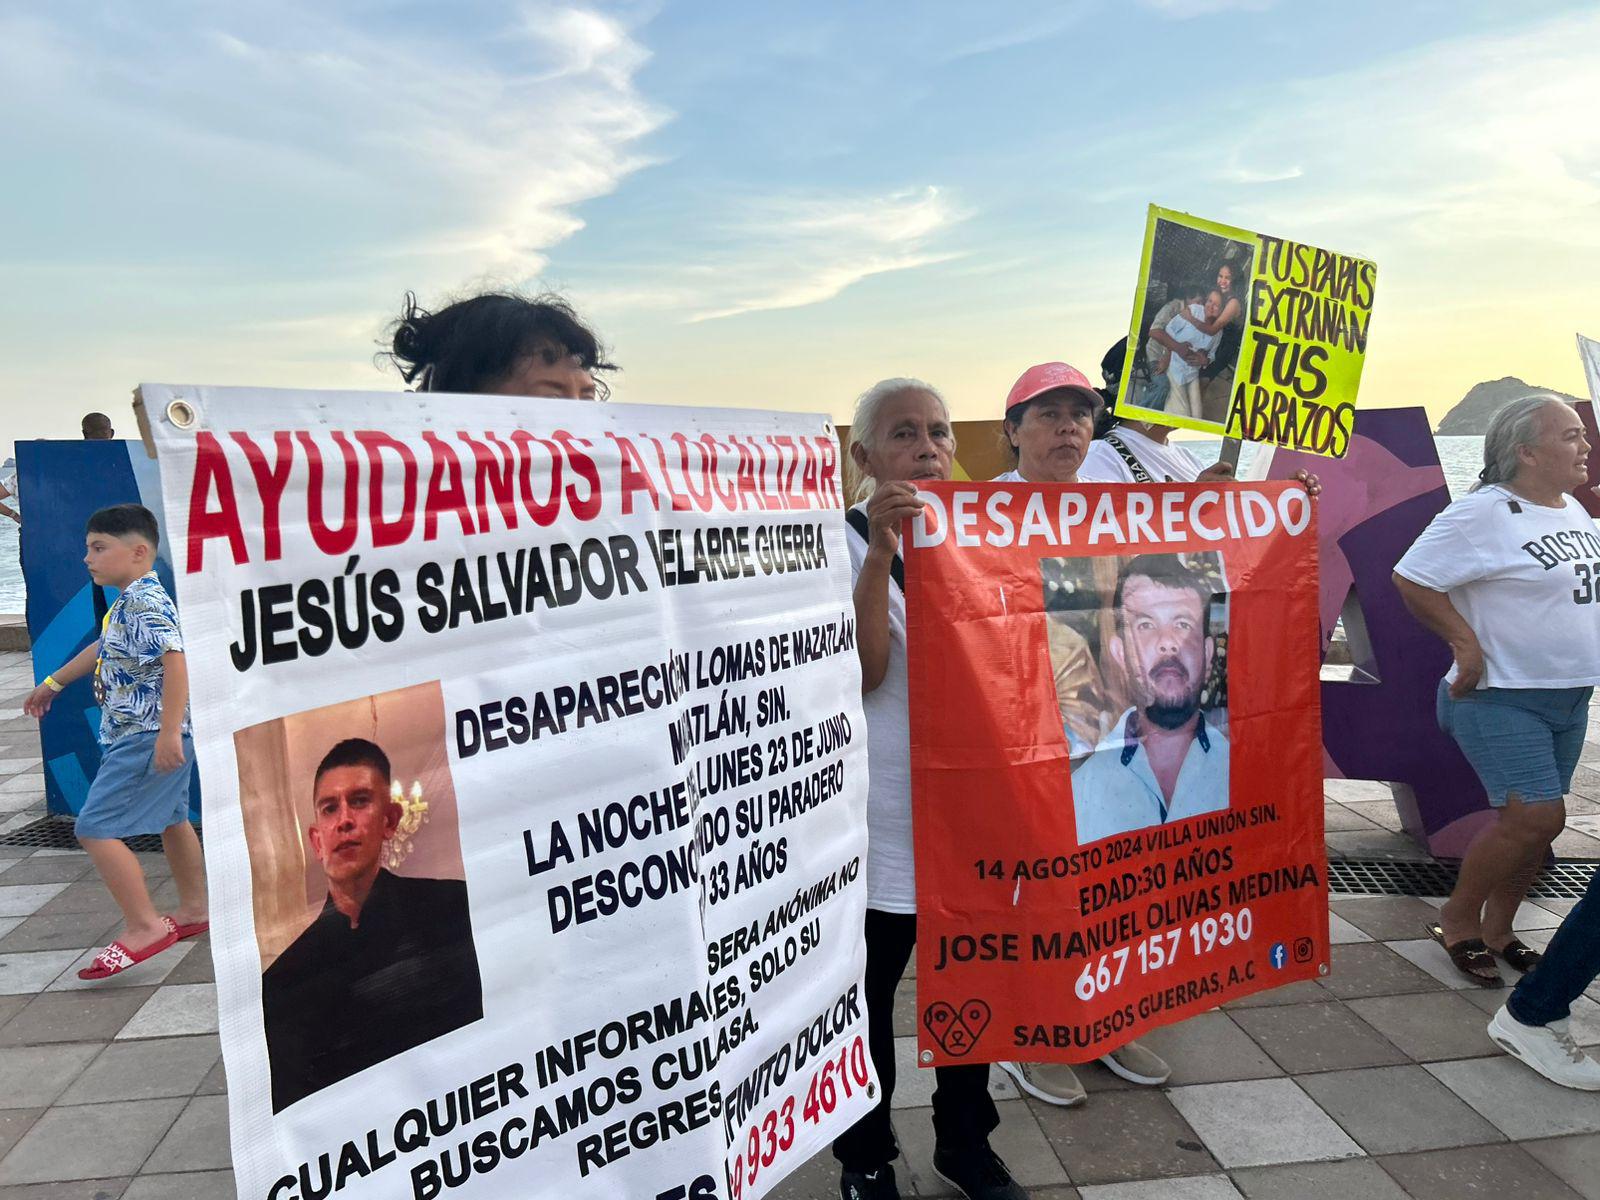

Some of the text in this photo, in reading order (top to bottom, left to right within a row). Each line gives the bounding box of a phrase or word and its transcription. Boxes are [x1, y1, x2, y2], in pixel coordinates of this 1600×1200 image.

[1256, 234, 1309, 287] TUS
[1249, 331, 1328, 399] TUS
[1225, 382, 1355, 459] ABRAZOS
[187, 429, 841, 573] AYUDANOS A LOCALIZAR
[913, 487, 1311, 548] DESAPARECIDO
[1521, 530, 1600, 571] BOSTO
[230, 523, 828, 672] JESÚS SALVADOR VELARDE GUERRA
[696, 640, 765, 689] LOMAS
[769, 633, 791, 672] DE
[792, 612, 854, 665] MAZATLÁN
[756, 685, 791, 727] SIN.
[523, 820, 574, 877] LA
[577, 781, 689, 857] NOCHE
[767, 737, 788, 776] 23
[792, 728, 813, 768] DE
[816, 713, 851, 757] JUNIO
[736, 794, 763, 838] SU
[768, 760, 843, 827] PARADERO
[709, 837, 788, 905] 33 AÑOS
[974, 803, 1280, 881] 14 AGOSTO 2024 VILLA UNIÓN SIN.
[1079, 845, 1233, 917] EDAD:30 AÑOS
[934, 863, 1320, 971] JOSE MANUEL OLIVAS MEDINA
[1074, 907, 1252, 1001] 667 157 1930
[535, 983, 713, 1090] INFORMA
[707, 920, 760, 976] SERA
[762, 872, 837, 943] ANÓNIMA
[839, 856, 859, 890] NO
[1013, 960, 1256, 1048] SABUESOS GUERRAS, A.C
[410, 1066, 642, 1200] BUSCAMOS
[750, 936, 797, 993] SOLO
[800, 917, 820, 956] SU
[795, 983, 861, 1072] DOLOR
[577, 1079, 722, 1178] REGRES
[748, 1095, 795, 1186] 933
[803, 1035, 869, 1126] 4610
